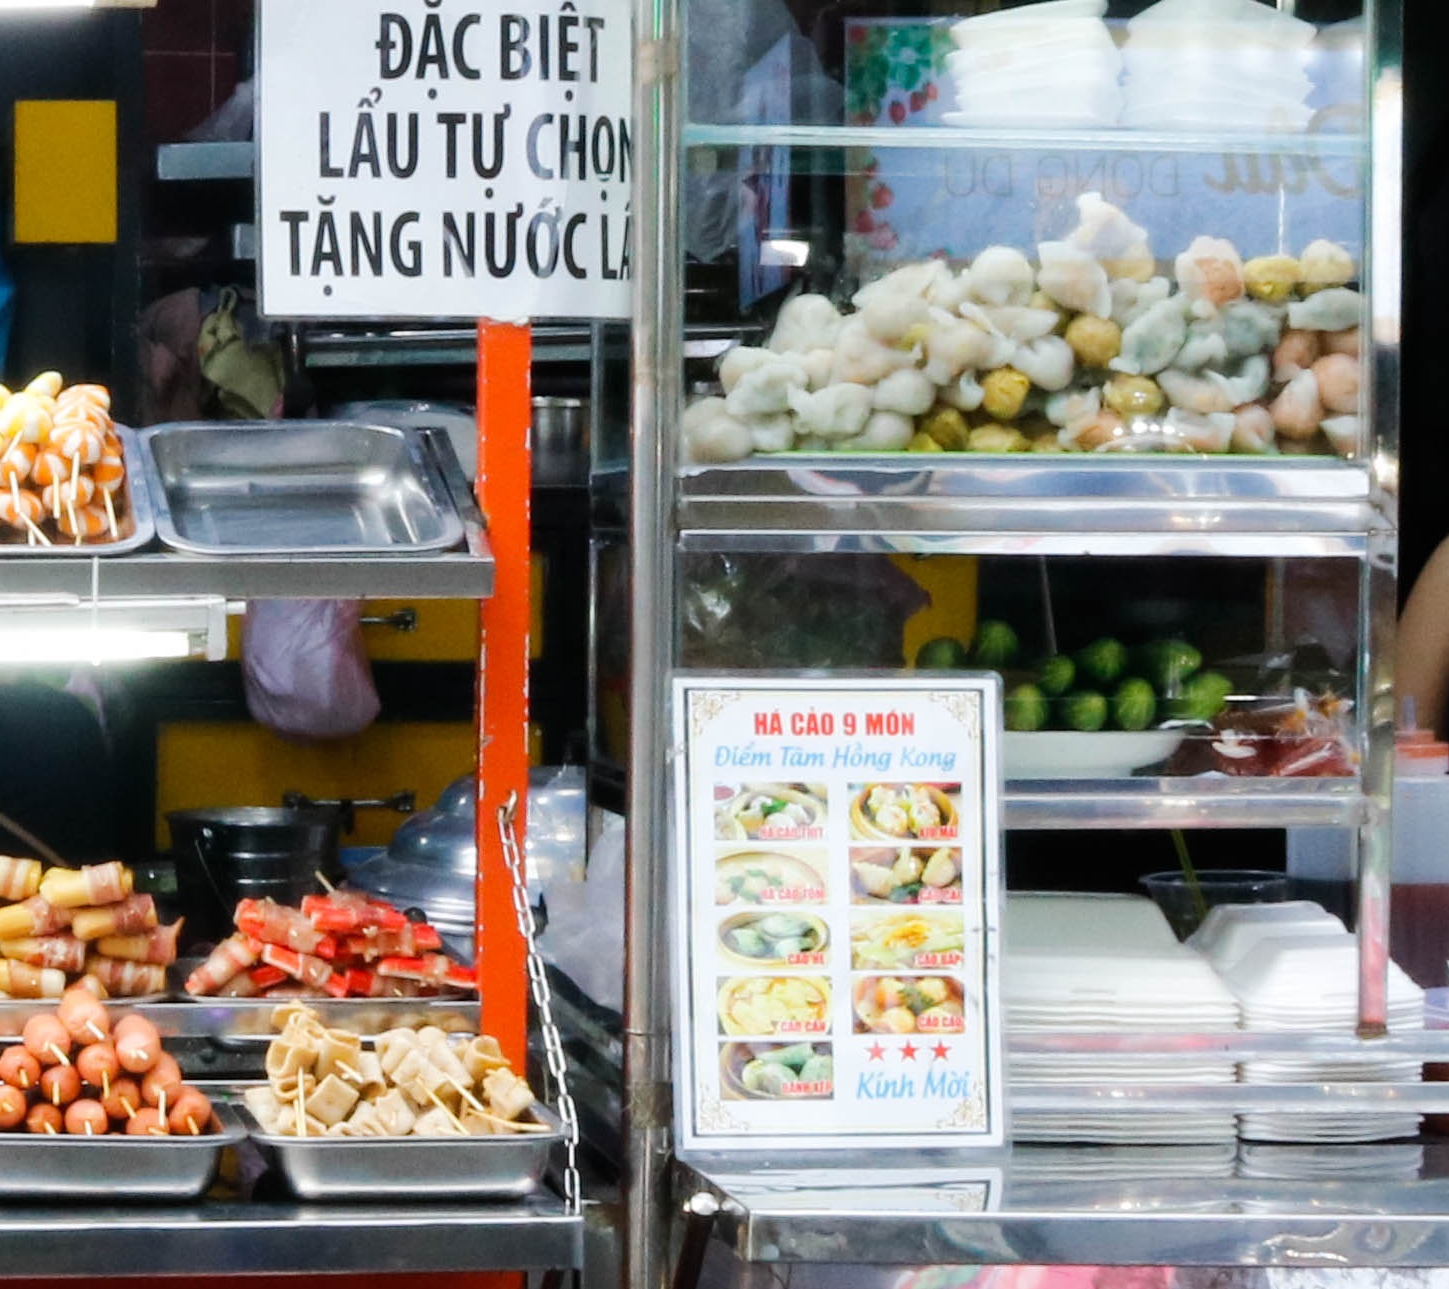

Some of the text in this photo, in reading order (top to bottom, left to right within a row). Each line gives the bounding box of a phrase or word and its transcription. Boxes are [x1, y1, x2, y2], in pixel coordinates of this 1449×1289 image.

[500, 1, 606, 102] BIỆT
[318, 86, 420, 179] LẨU
[436, 103, 512, 200] TỰ
[279, 194, 423, 297] TẶNG
[443, 196, 588, 281] NƯỚC
[754, 707, 915, 737] HÁ CẢO 9 MÓN
[714, 740, 957, 772] Điểm Tâm Hồng Kong
[856, 1069, 916, 1100] Kính
